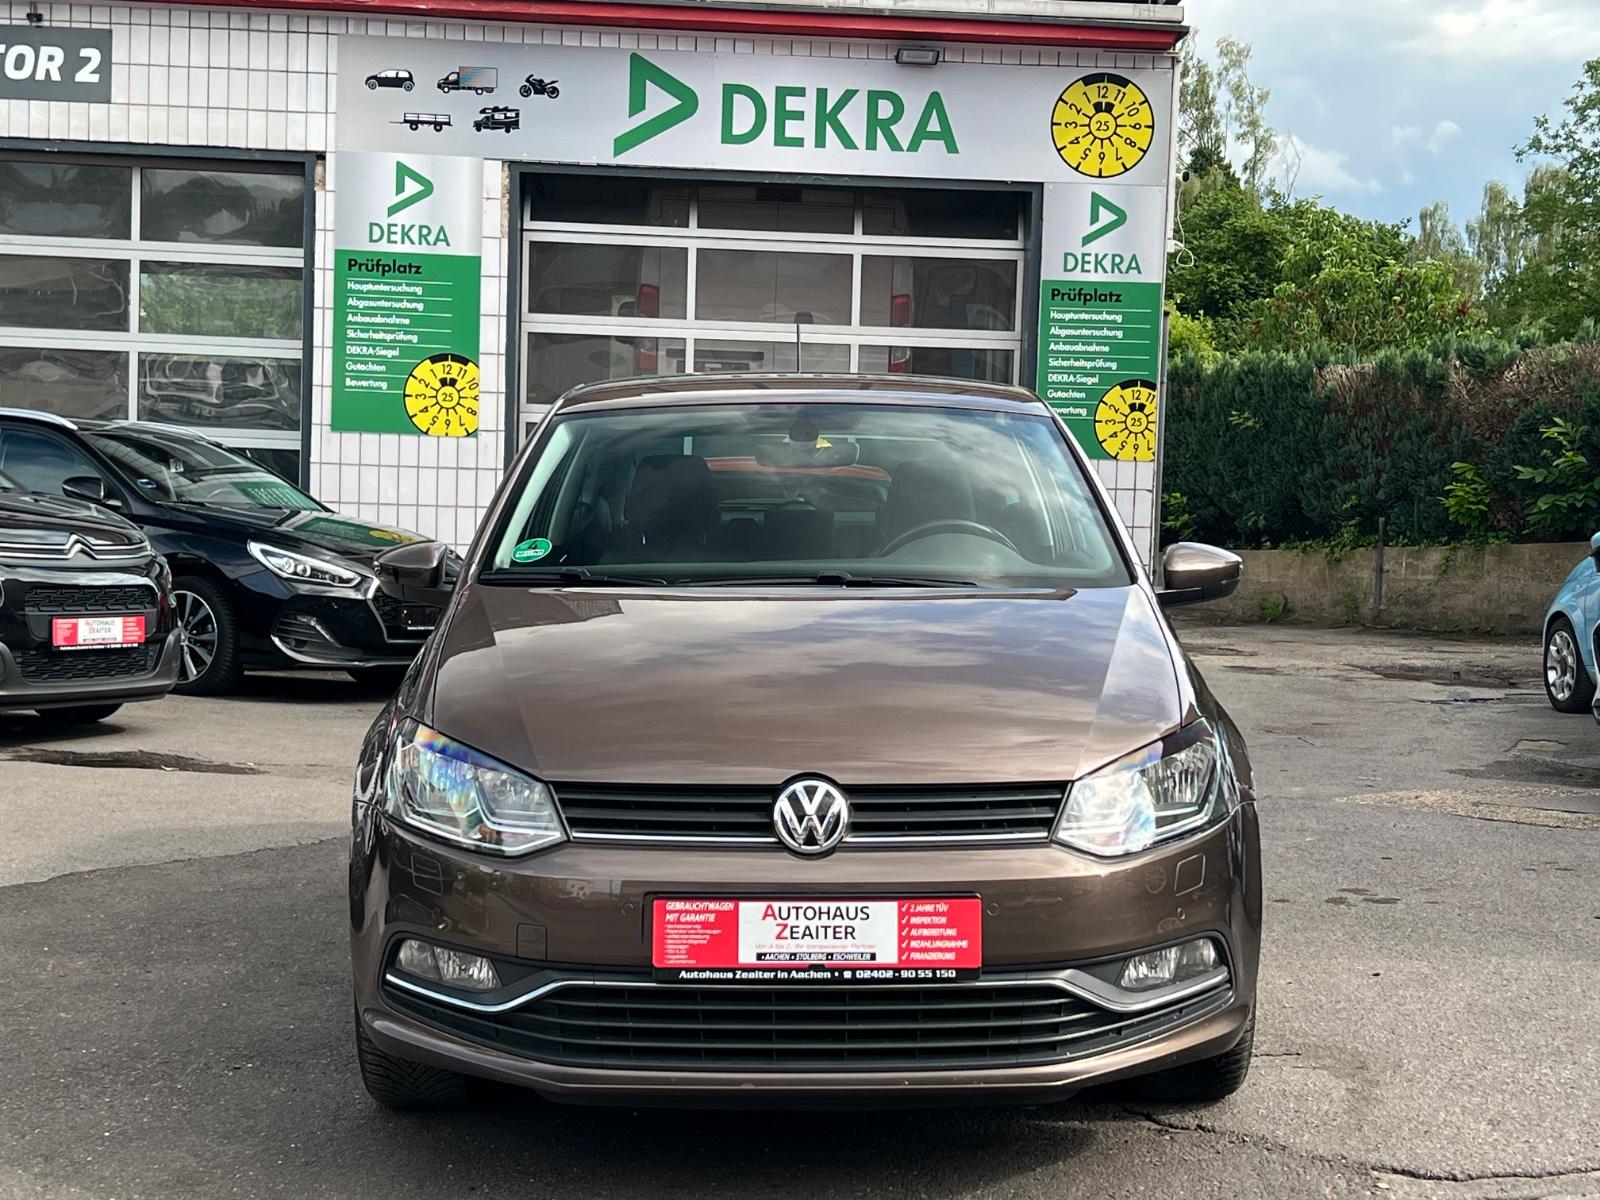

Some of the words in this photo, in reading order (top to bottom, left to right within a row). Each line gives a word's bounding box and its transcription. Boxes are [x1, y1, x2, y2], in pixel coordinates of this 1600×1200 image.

[0, 44, 64, 81] OR
[75, 47, 102, 83] 2
[1083, 91, 1091, 104] 1
[1096, 85, 1109, 99] 12
[1114, 88, 1126, 104] 11
[1068, 103, 1082, 115] 2
[1125, 101, 1140, 117] 10
[720, 83, 960, 154] DEKRA
[1064, 121, 1078, 129] 3
[1095, 120, 1110, 132] 25
[1068, 136, 1080, 145] 4
[1124, 137, 1137, 148] 8
[1080, 147, 1091, 160] 5
[368, 222, 451, 247] DEKRA
[347, 258, 422, 277] Prüfplatz
[1062, 252, 1142, 275] DEKRA
[347, 281, 423, 295] Hauptuntersuchung
[1050, 288, 1122, 306] Prüfplatz
[346, 297, 424, 312] Abgasuntersuchung
[346, 313, 410, 325] Anbauabnahme
[1049, 310, 1123, 323] Hauptuntersuchung
[346, 329, 418, 343] Sicherheitsprüfung
[1049, 325, 1123, 339] Abgasuntersuchung
[346, 345, 400, 358] DEKRA-Siegel
[1048, 342, 1110, 353] Anbauabnahme
[345, 361, 386, 372] Gutachten
[441, 364, 453, 375] 12
[1048, 358, 1118, 370] Sicherheitsprüfung
[457, 367, 468, 379] 11
[1047, 373, 1099, 385] DEKRA-Siegel
[345, 377, 388, 390] Bewertung
[419, 378, 430, 389] 2
[441, 392, 454, 402] 25
[1047, 389, 1086, 399] Gutachten
[1131, 389, 1142, 401] 12
[1108, 403, 1120, 414] 2
[1130, 417, 1143, 427] 25
[665, 901, 735, 911] GEBRAUCHTWAGEN
[935, 902, 949, 912] TÜV
[665, 913, 680, 922] MIT
[680, 913, 716, 922] GARANTIE
[761, 904, 870, 921] AUTOHAUS
[775, 923, 857, 940] ZEAITER
[679, 970, 734, 979] Autohaus
[735, 970, 776, 979] Zeaiter
[777, 970, 788, 979] in
[790, 970, 831, 979] Aachen
[855, 969, 894, 979] 02402
[917, 969, 933, 978] 55
[935, 969, 956, 978] 150
